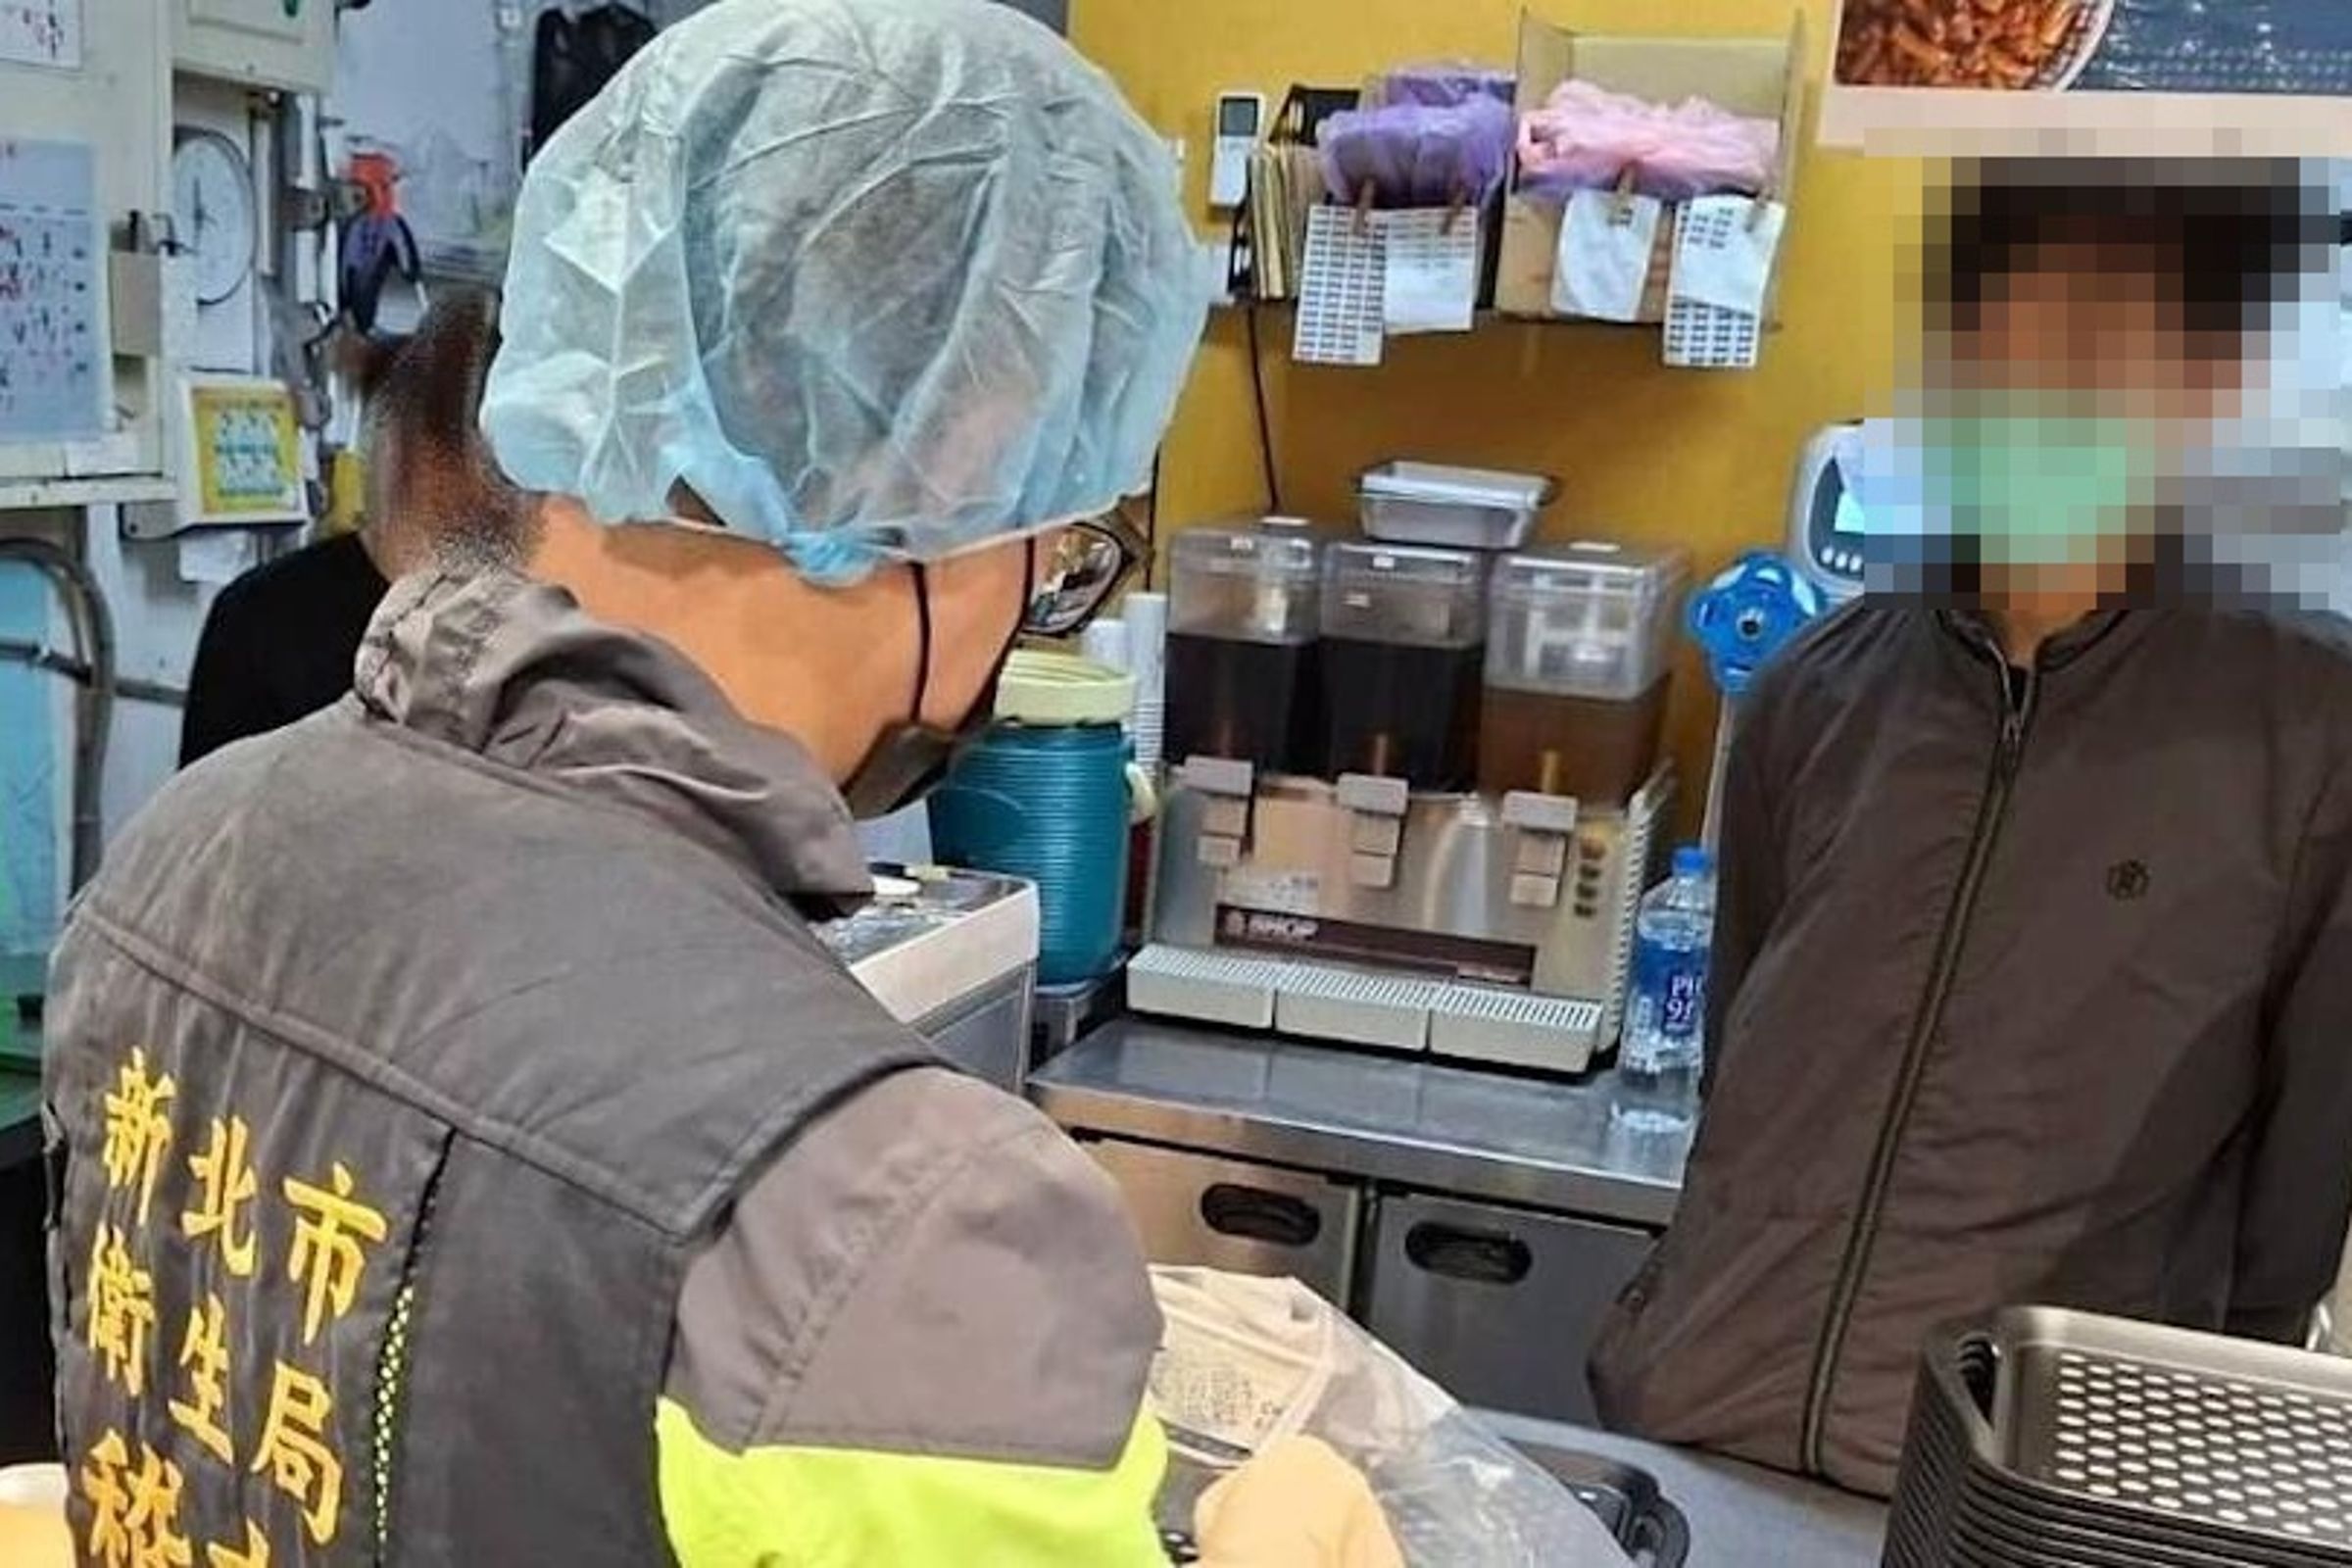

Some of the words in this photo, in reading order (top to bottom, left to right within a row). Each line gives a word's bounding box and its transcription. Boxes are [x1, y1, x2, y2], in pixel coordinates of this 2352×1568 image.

[103, 1046, 388, 1347] 新北市
[87, 1221, 343, 1544] 衛生局
